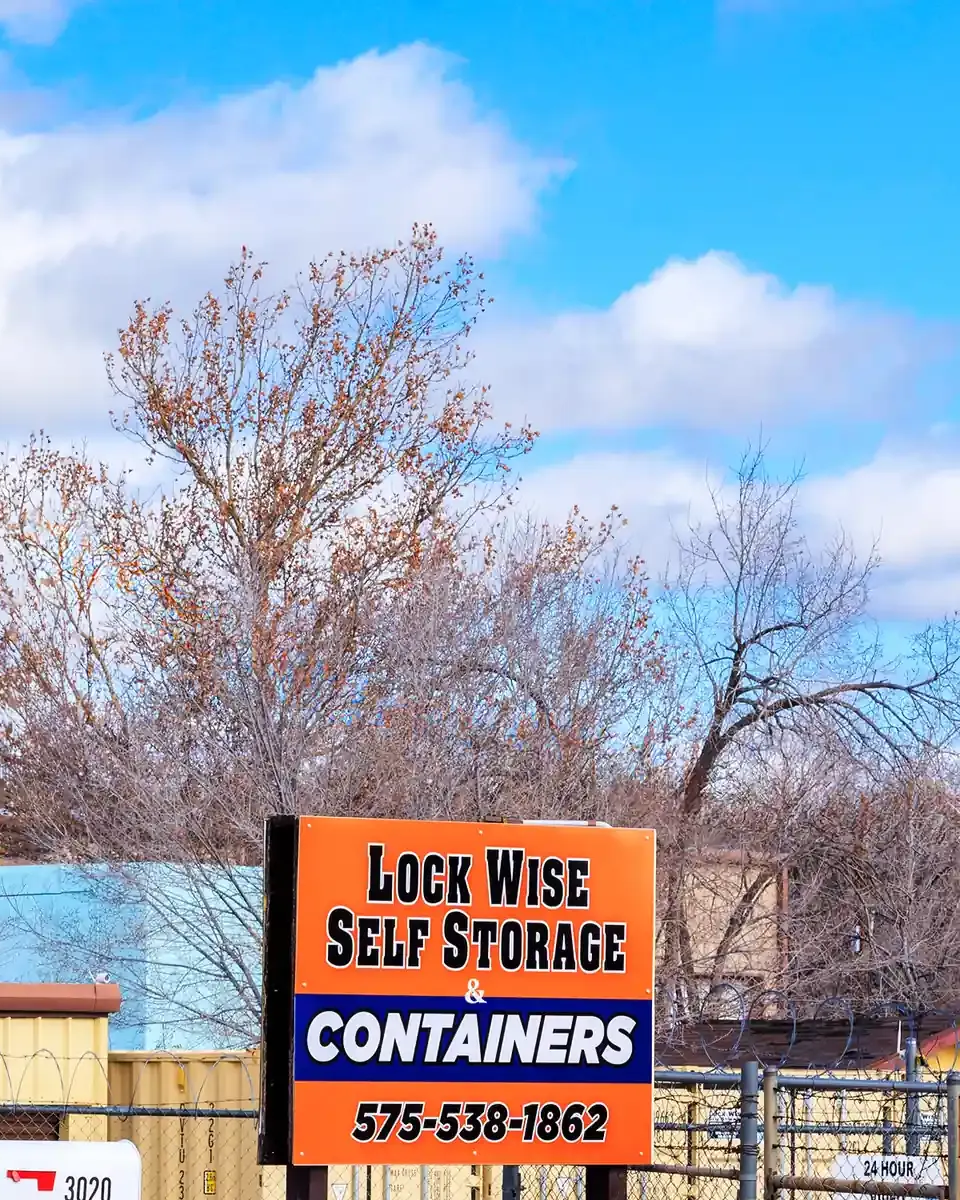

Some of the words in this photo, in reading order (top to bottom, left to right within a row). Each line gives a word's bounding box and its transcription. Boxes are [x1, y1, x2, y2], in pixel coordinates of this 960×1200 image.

[366, 842, 473, 906] LOCK
[485, 846, 591, 910] WISE
[325, 906, 431, 970] SELF
[441, 909, 628, 974] STORAGE
[464, 978, 487, 1004] &
[306, 1010, 637, 1066] CONTAINERS
[350, 1101, 609, 1143] 575-538-1862
[864, 1160, 878, 1176] 24
[881, 1160, 914, 1177] HOUR
